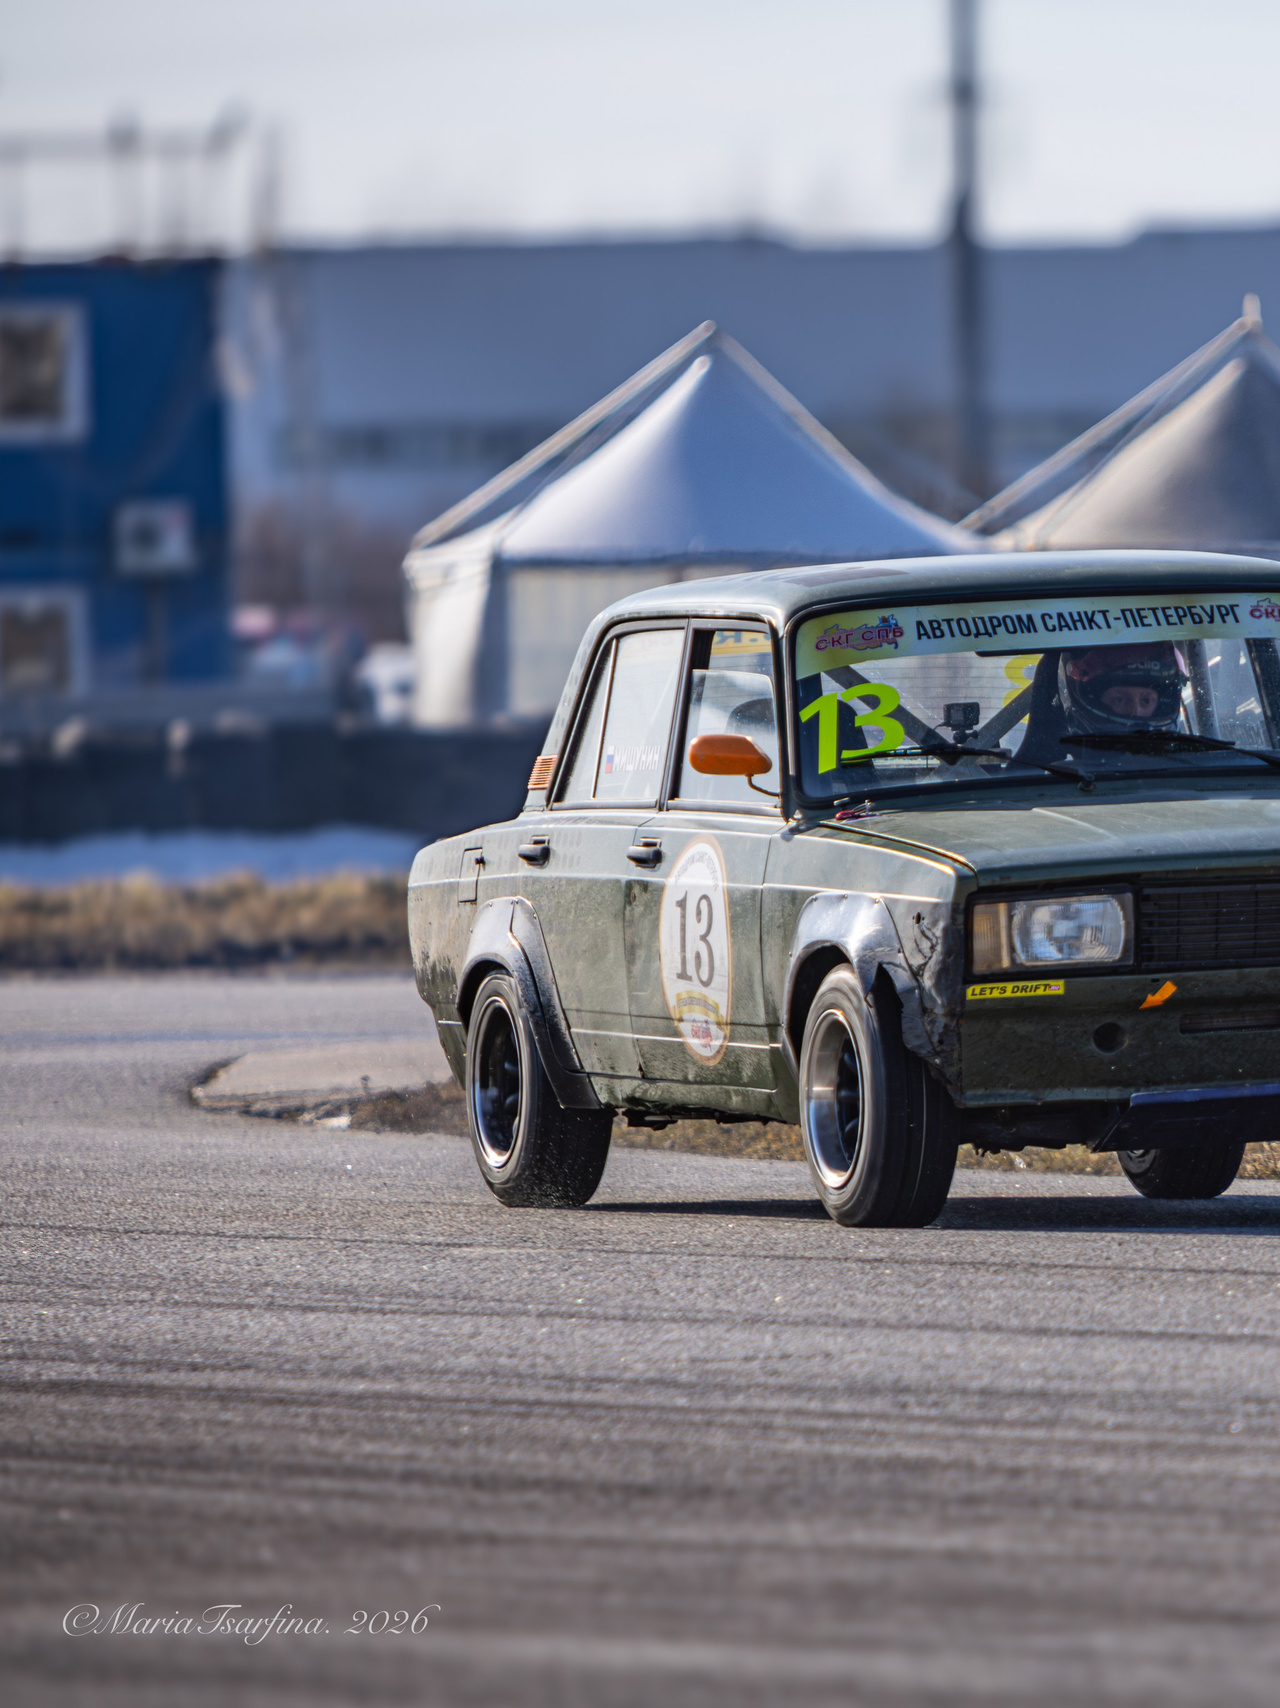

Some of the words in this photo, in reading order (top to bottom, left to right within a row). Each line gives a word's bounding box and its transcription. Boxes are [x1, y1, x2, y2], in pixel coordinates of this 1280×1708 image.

[916, 614, 1037, 640] АВТОДРОМ
[1041, 604, 1240, 632] САНКТ-ПЕТЕРБУРГ
[815, 632, 855, 652] СКГ
[861, 626, 905, 641] СПБ
[798, 682, 906, 774] 13
[613, 745, 660, 771] МИШУНИН
[675, 891, 715, 988] 13
[970, 985, 1007, 997] LET'S
